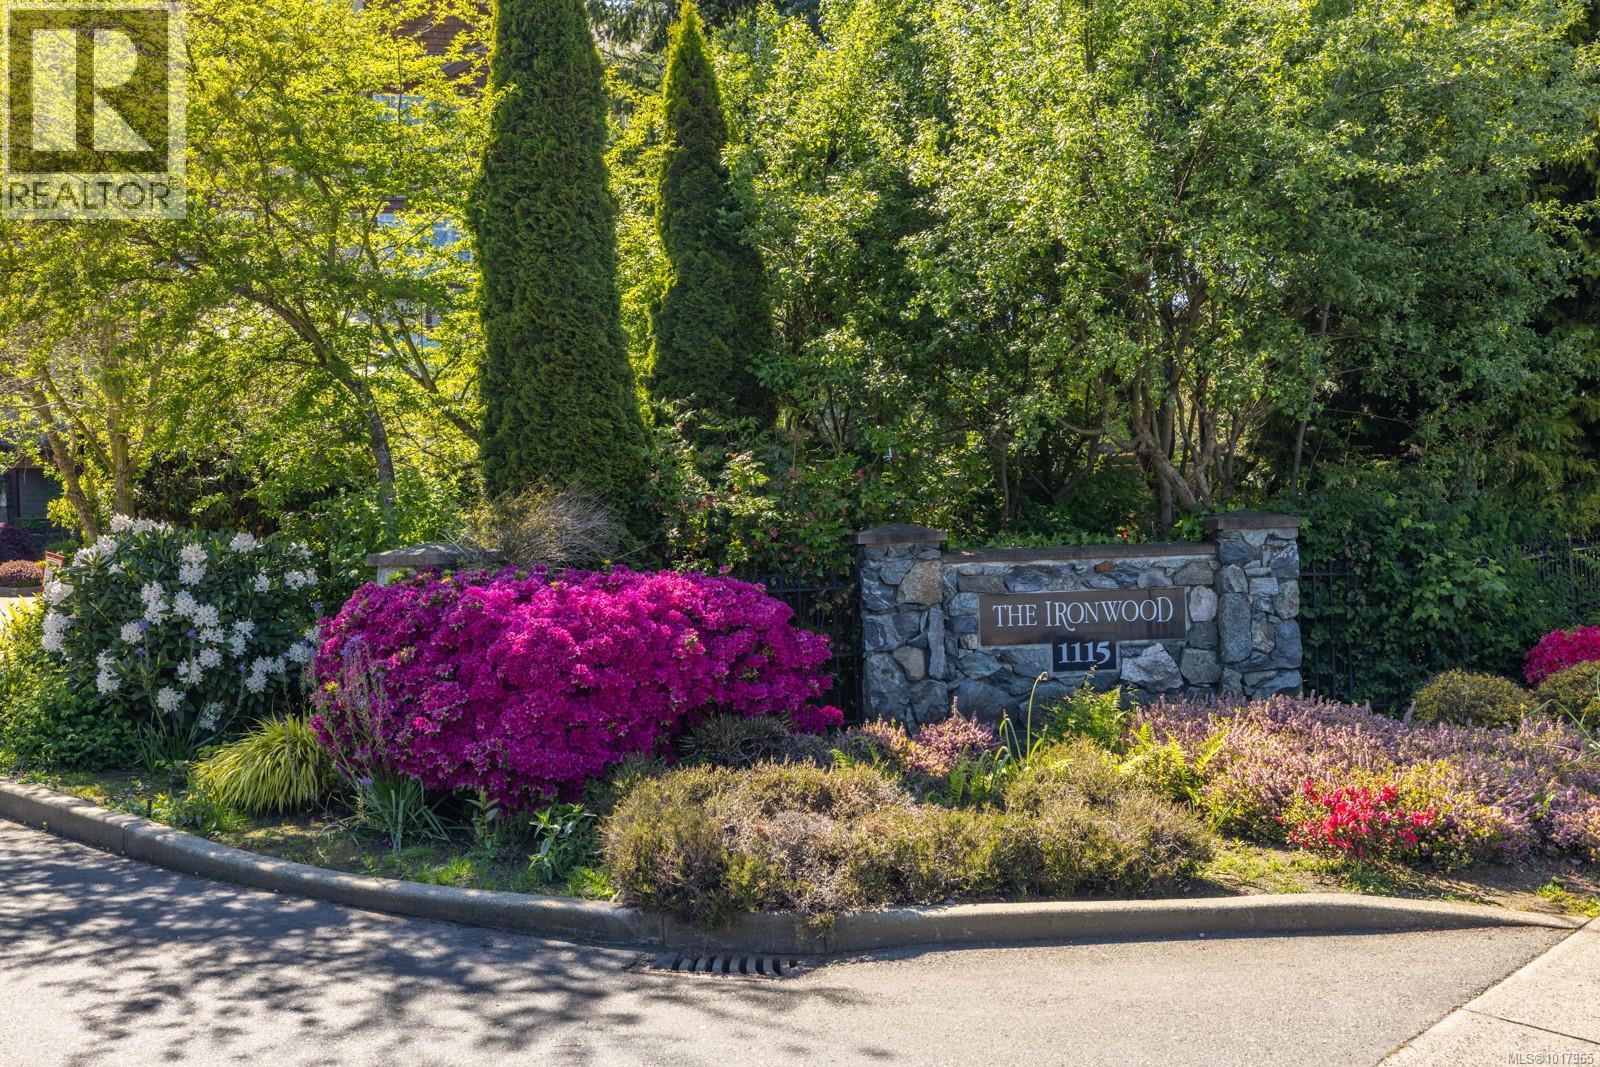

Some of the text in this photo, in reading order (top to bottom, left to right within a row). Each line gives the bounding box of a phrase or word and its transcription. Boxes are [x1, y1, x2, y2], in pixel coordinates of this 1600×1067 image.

[993, 596, 1174, 632] THE IRONWOOD
[1058, 640, 1111, 665] 1115
